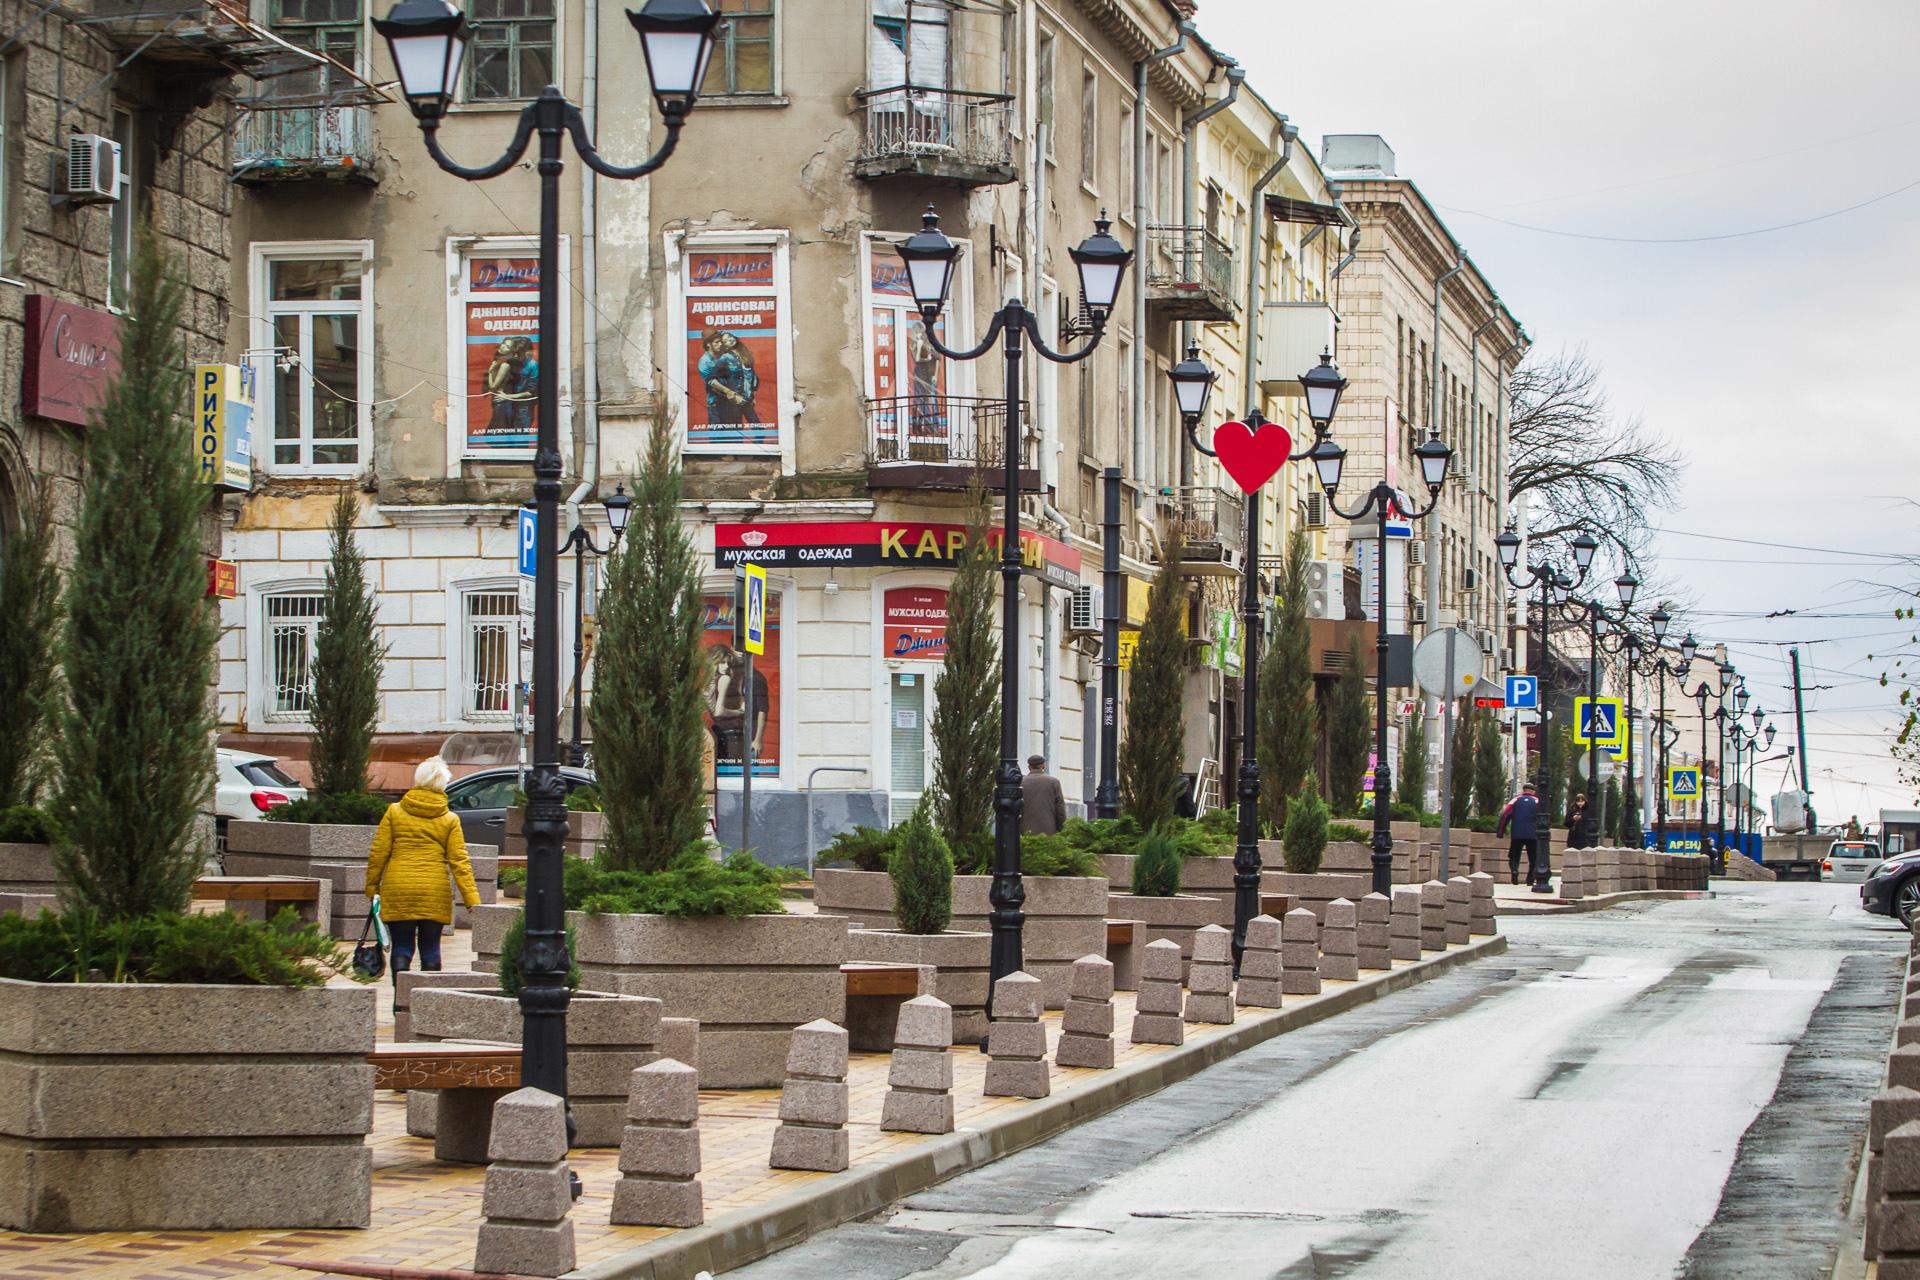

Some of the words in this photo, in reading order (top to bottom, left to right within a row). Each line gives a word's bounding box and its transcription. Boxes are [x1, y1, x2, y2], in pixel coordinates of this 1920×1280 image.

[471, 307, 540, 319] ДЖИНСОВ
[692, 301, 776, 314] ДЖИНСОВАЯ
[705, 314, 762, 326] ОДЕЖДА
[201, 371, 217, 473] РИКОН
[724, 549, 786, 563] мужская
[798, 548, 852, 561] одежда
[888, 607, 925, 617] МУЖСКАЯ
[926, 608, 950, 618] ОДЕЖ
[1514, 680, 1531, 704] P
